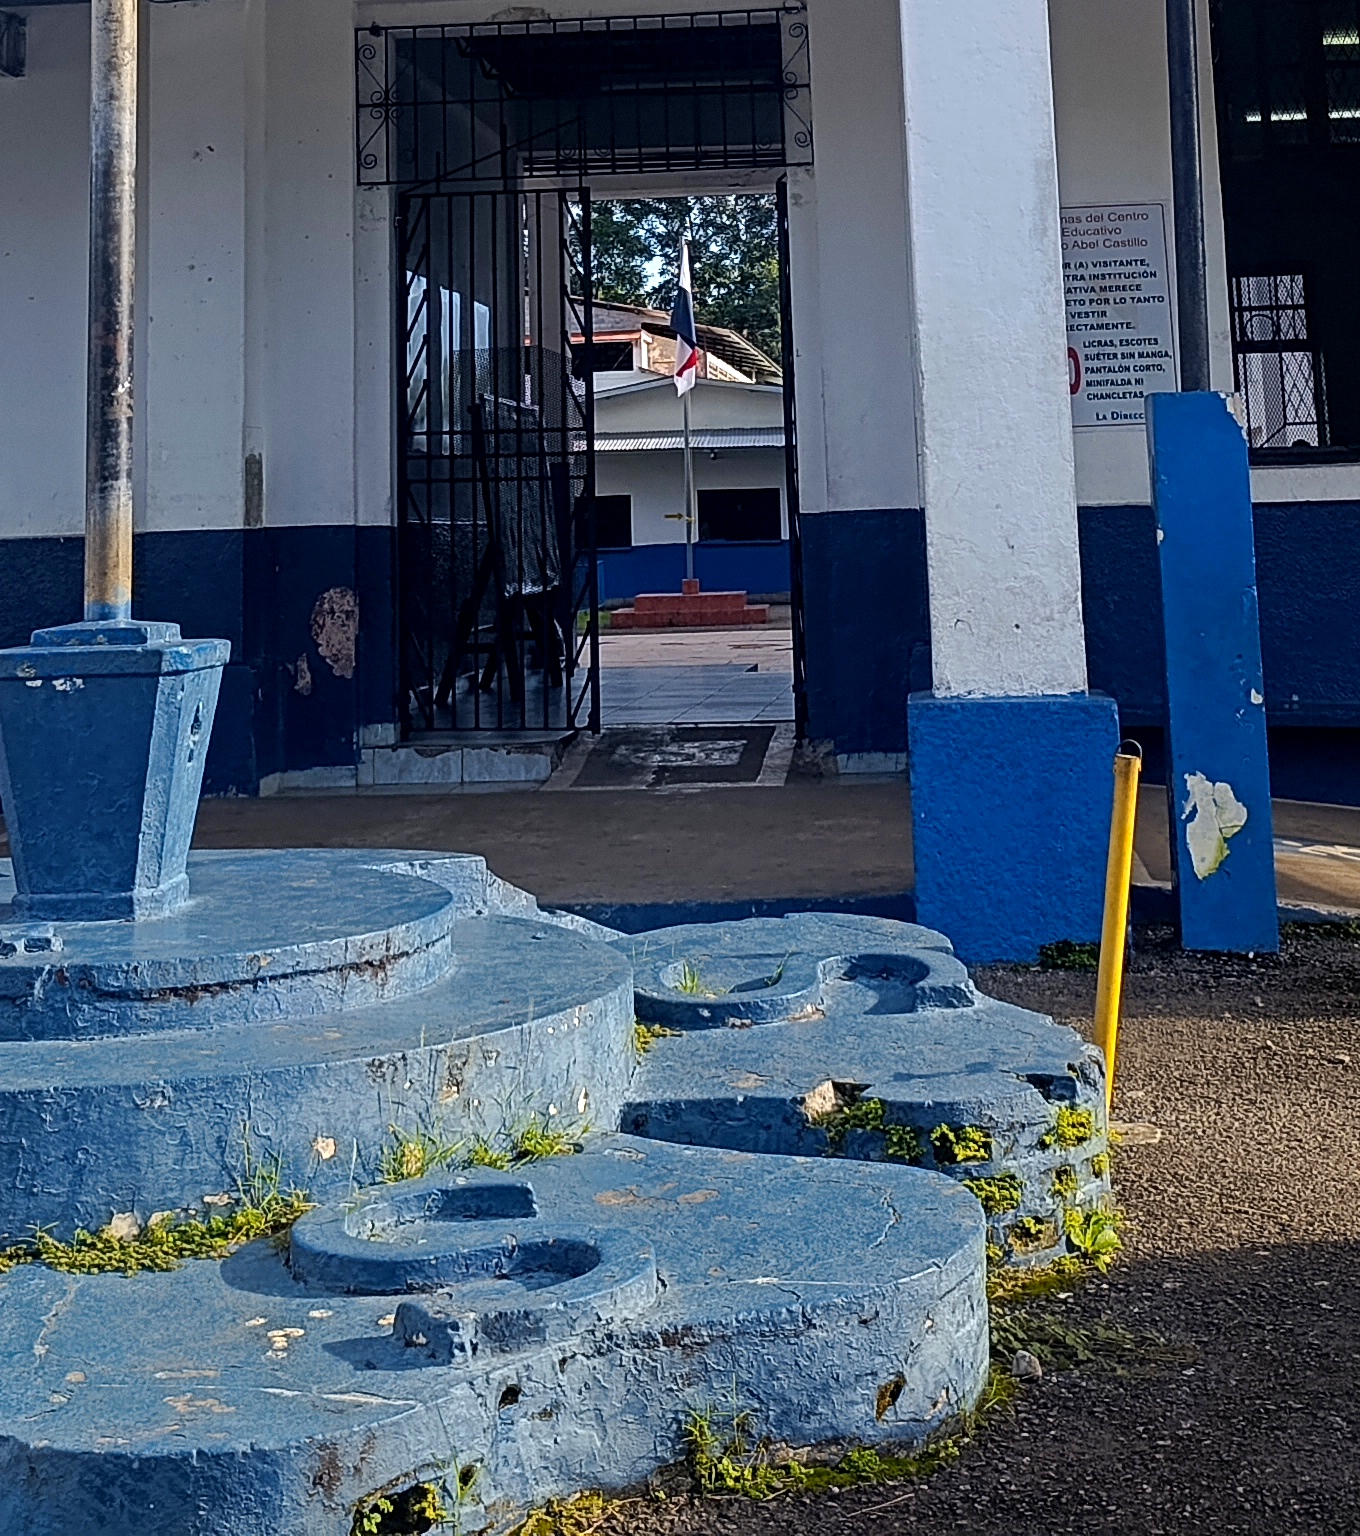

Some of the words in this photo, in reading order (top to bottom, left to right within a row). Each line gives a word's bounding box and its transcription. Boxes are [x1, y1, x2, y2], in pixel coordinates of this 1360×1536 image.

[1085, 213, 1104, 223] del
[1107, 211, 1149, 223] Centro
[1062, 225, 1122, 237] Educativo
[1071, 239, 1099, 250] Abel
[1102, 237, 1148, 249] Castillo
[1090, 258, 1150, 268] VISITANTE,
[1088, 269, 1157, 281] INSTITUCIÓN
[1065, 285, 1097, 295] ATIVA
[1099, 284, 1143, 293] MERECE
[1088, 297, 1111, 306] POR
[1113, 296, 1127, 305] LO
[1129, 295, 1165, 304] TANTO
[1069, 310, 1108, 319] VESTIR
[1082, 339, 1118, 349] LICRAS,
[1118, 337, 1159, 347] ESCOTES
[1084, 351, 1118, 361] SUÉTER
[1120, 351, 1136, 360] SIN
[1137, 350, 1172, 360] MANGA,
[1084, 364, 1131, 375] PANTALÓN
[1132, 363, 1166, 373] CORTO,
[1085, 378, 1133, 387] MINIFALDA
[1134, 377, 1144, 386] NI
[1086, 390, 1145, 401] CHANCLETAS
